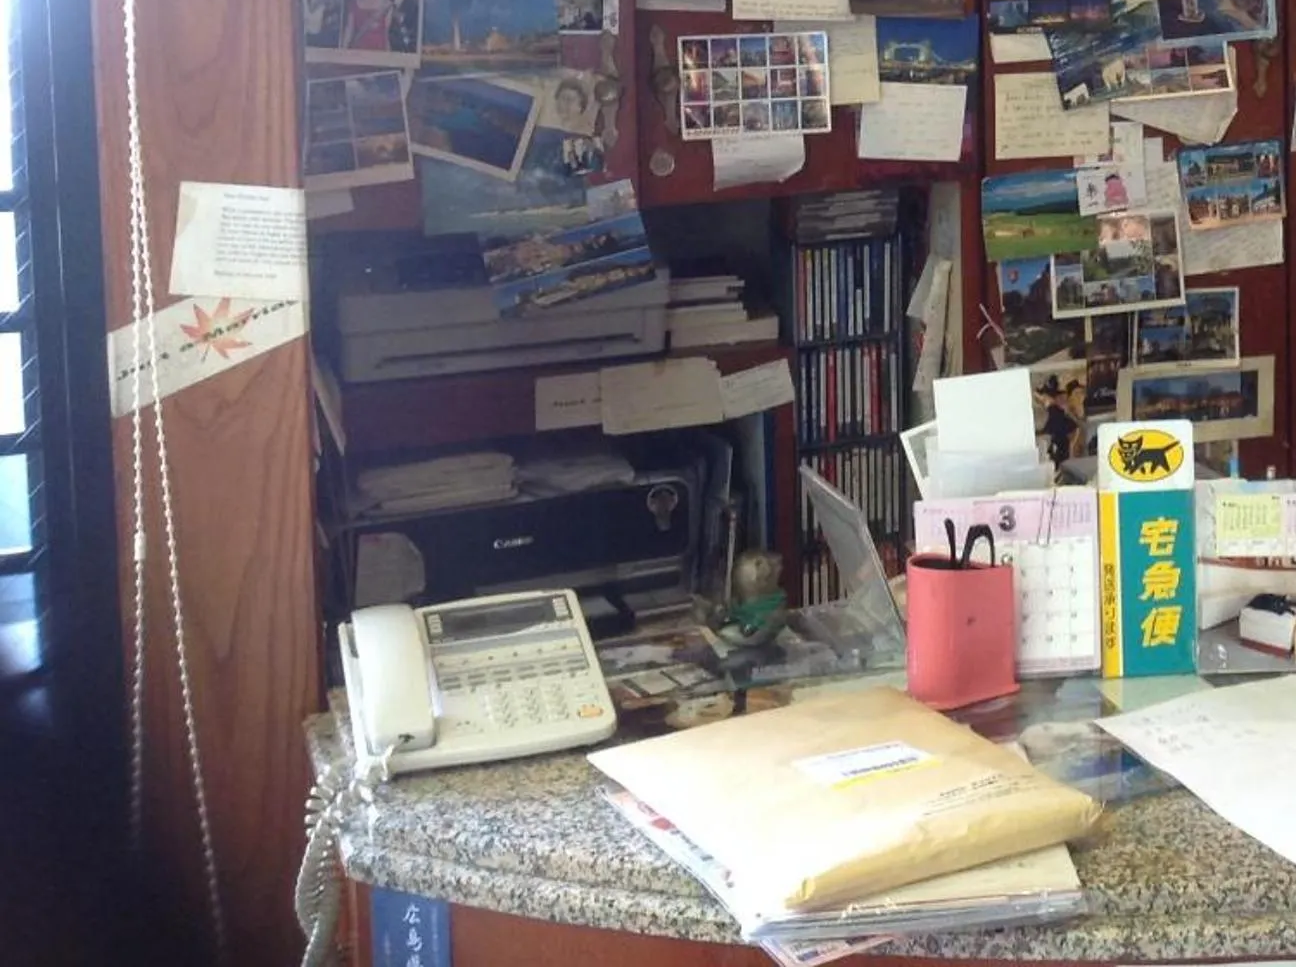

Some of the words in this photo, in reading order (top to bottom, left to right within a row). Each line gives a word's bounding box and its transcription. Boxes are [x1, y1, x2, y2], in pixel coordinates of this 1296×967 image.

[998, 505, 1016, 531] 3
[1138, 516, 1183, 648] 宅急便
